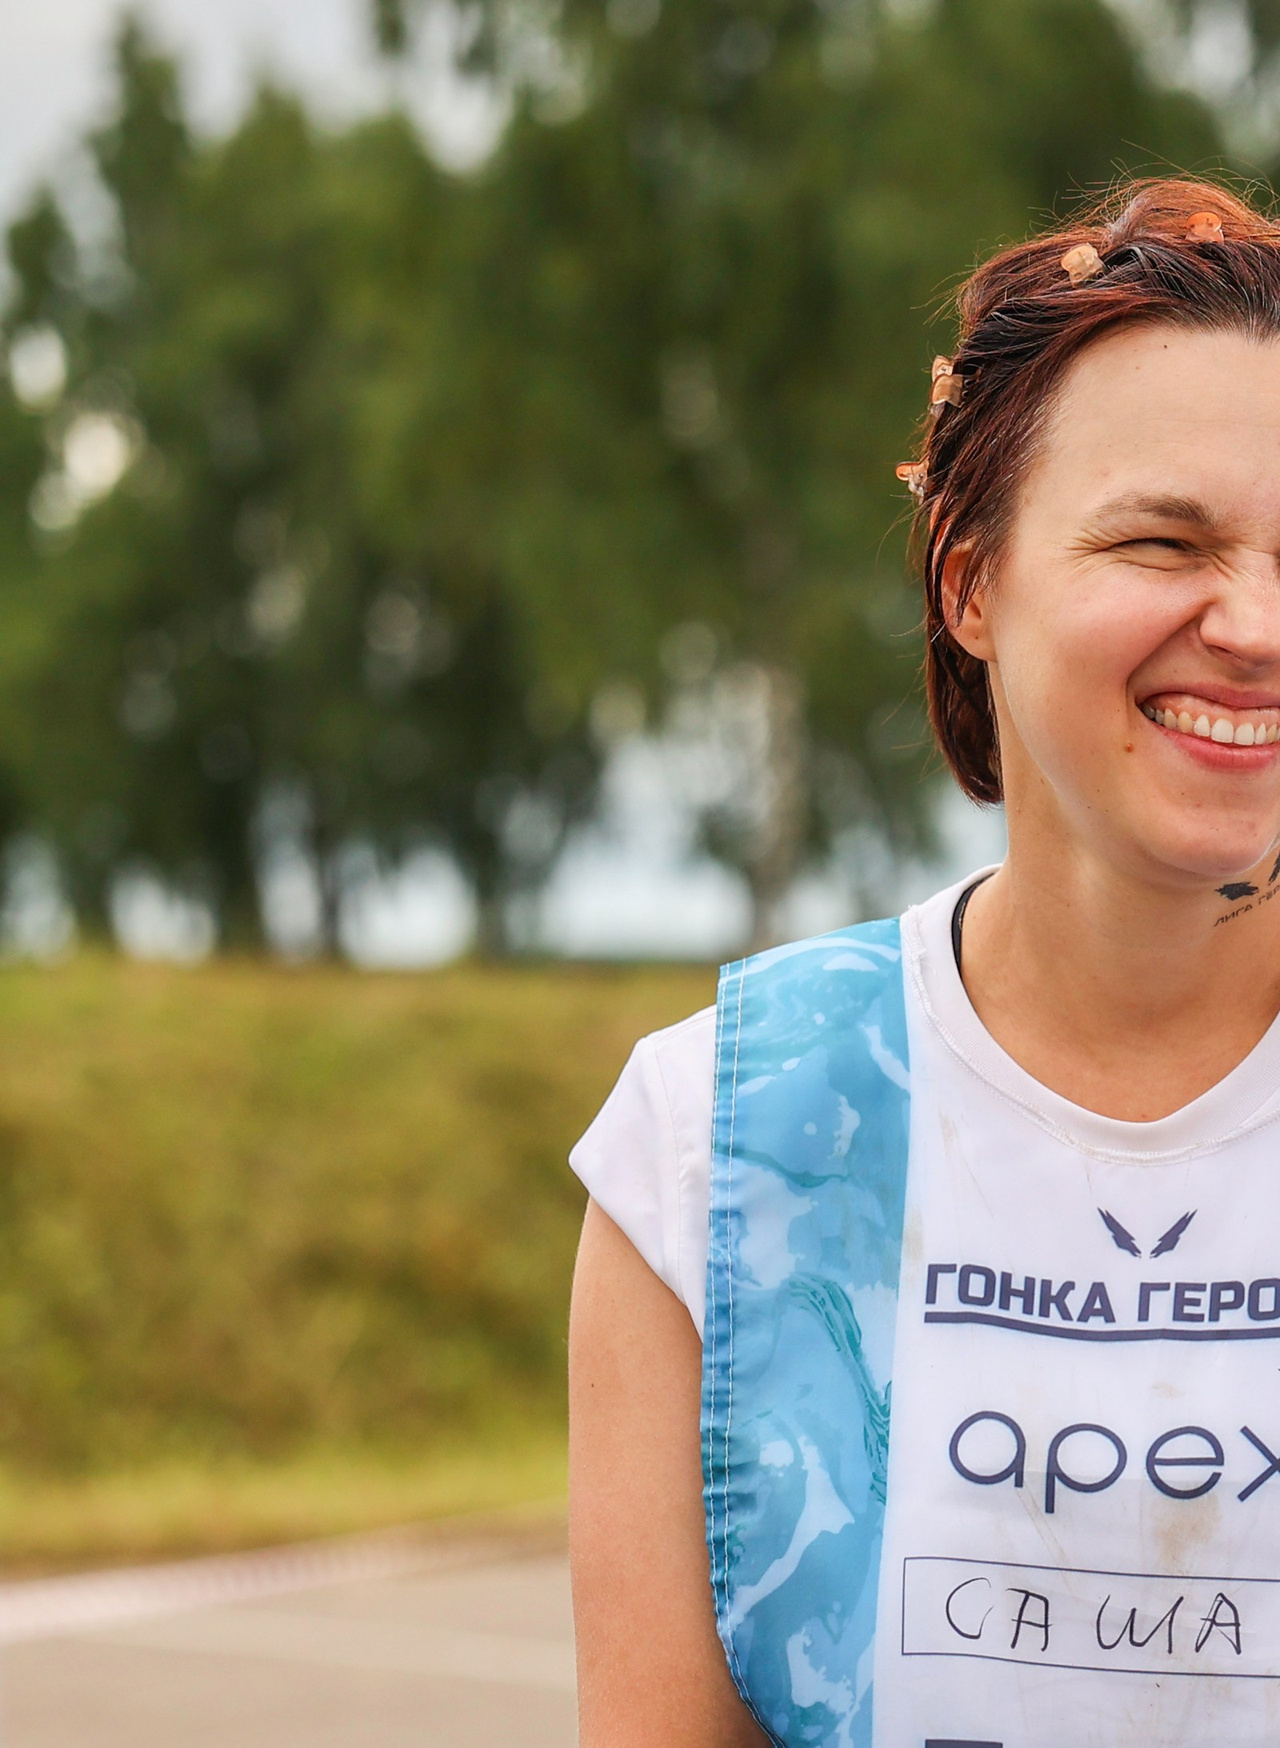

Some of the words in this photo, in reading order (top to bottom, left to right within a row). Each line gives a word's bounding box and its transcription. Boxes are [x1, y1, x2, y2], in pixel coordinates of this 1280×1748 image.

[1213, 903, 1254, 928] ЛИГА
[924, 1263, 1116, 1323] ГОНКА
[945, 1577, 1242, 1656] САША
